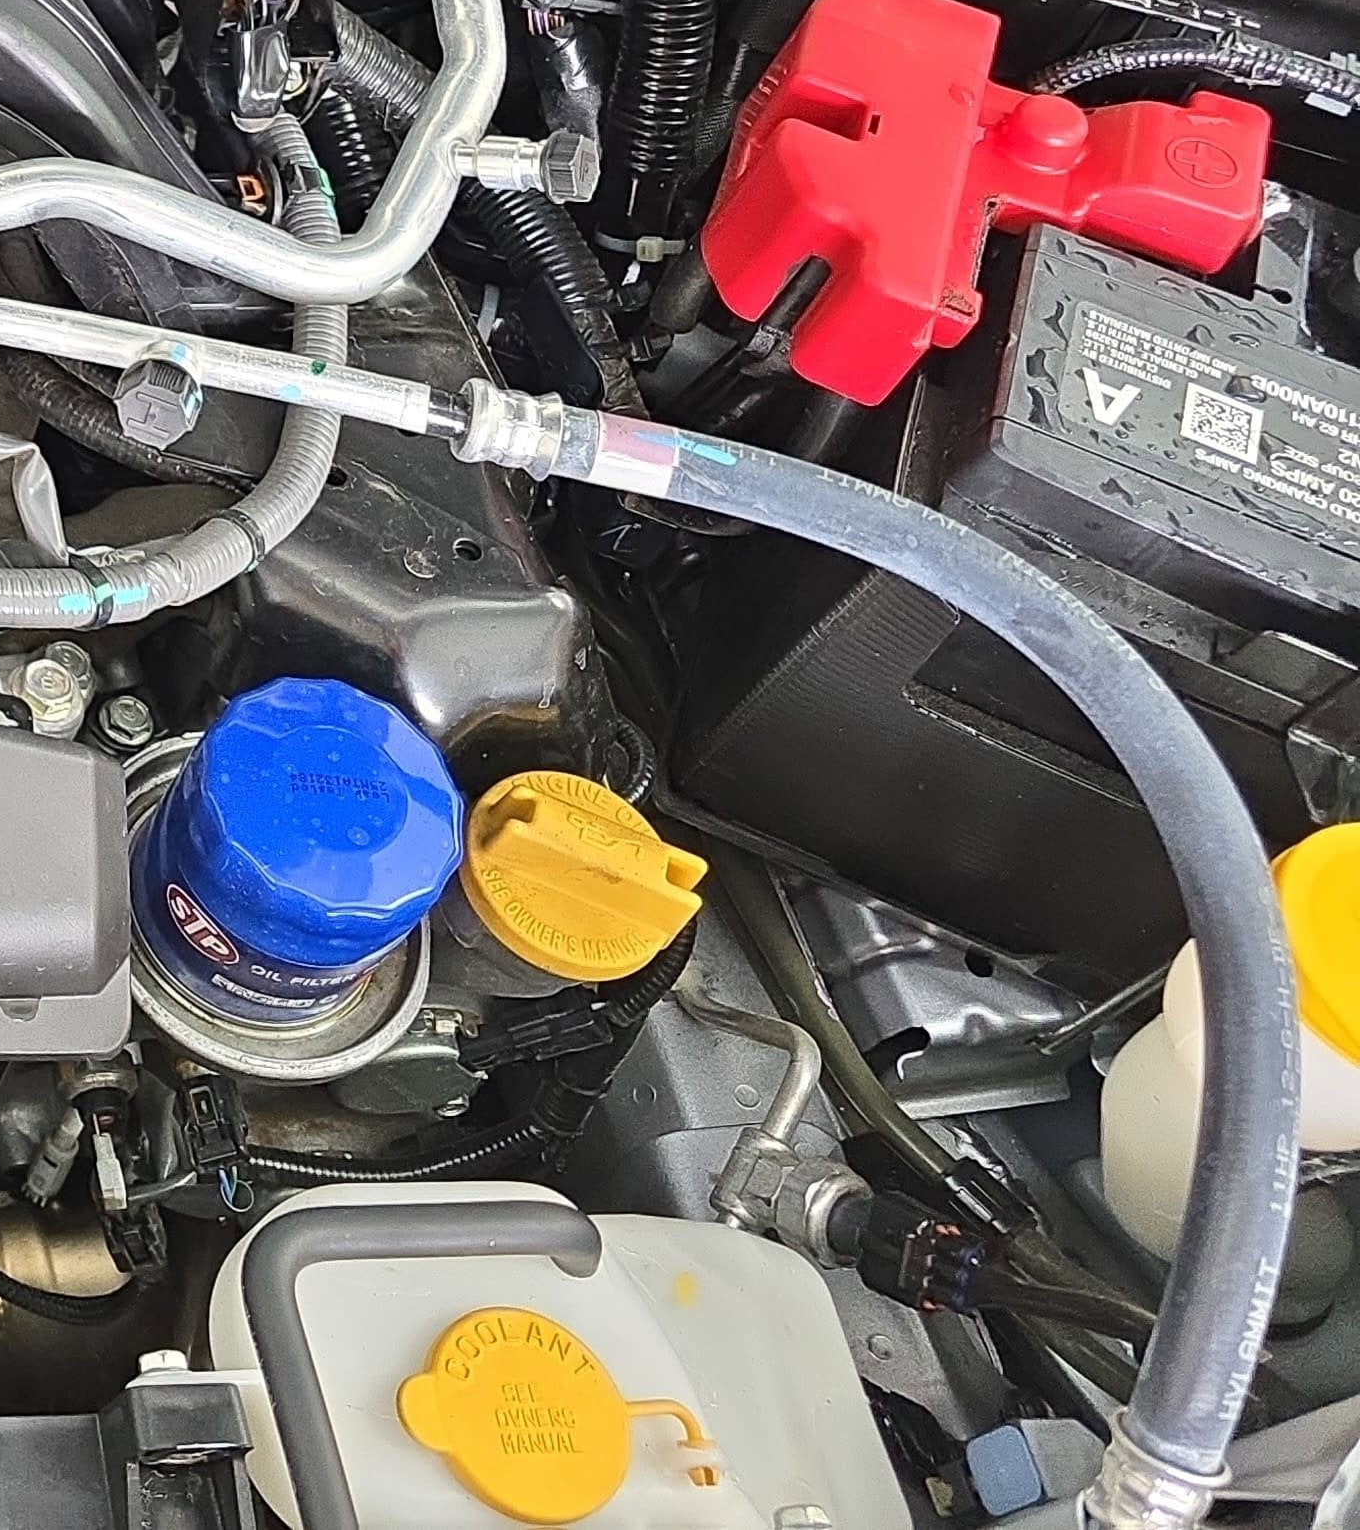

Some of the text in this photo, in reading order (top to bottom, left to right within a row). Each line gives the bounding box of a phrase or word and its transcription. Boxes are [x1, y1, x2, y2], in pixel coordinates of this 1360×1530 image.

[1108, 327, 1137, 346] WITH
[1099, 354, 1172, 390] DISTRIBUTED
[1189, 358, 1223, 379] MADE
[1212, 359, 1238, 374] AND
[1082, 367, 1141, 426] A
[1292, 410, 1318, 428] AH
[1318, 421, 1340, 436] 62
[1195, 448, 1243, 474] AMPS
[1243, 467, 1328, 509] CRANKING
[1270, 460, 1336, 495] AMPS
[483, 868, 508, 900] SEE
[505, 901, 579, 957] OWNER'S
[170, 895, 231, 956] STP
[250, 964, 357, 987] OIL FILTER
[445, 1317, 597, 1381] COOLANT
[495, 1407, 576, 1429] OWNERS
[500, 1431, 584, 1455] MANUAL
